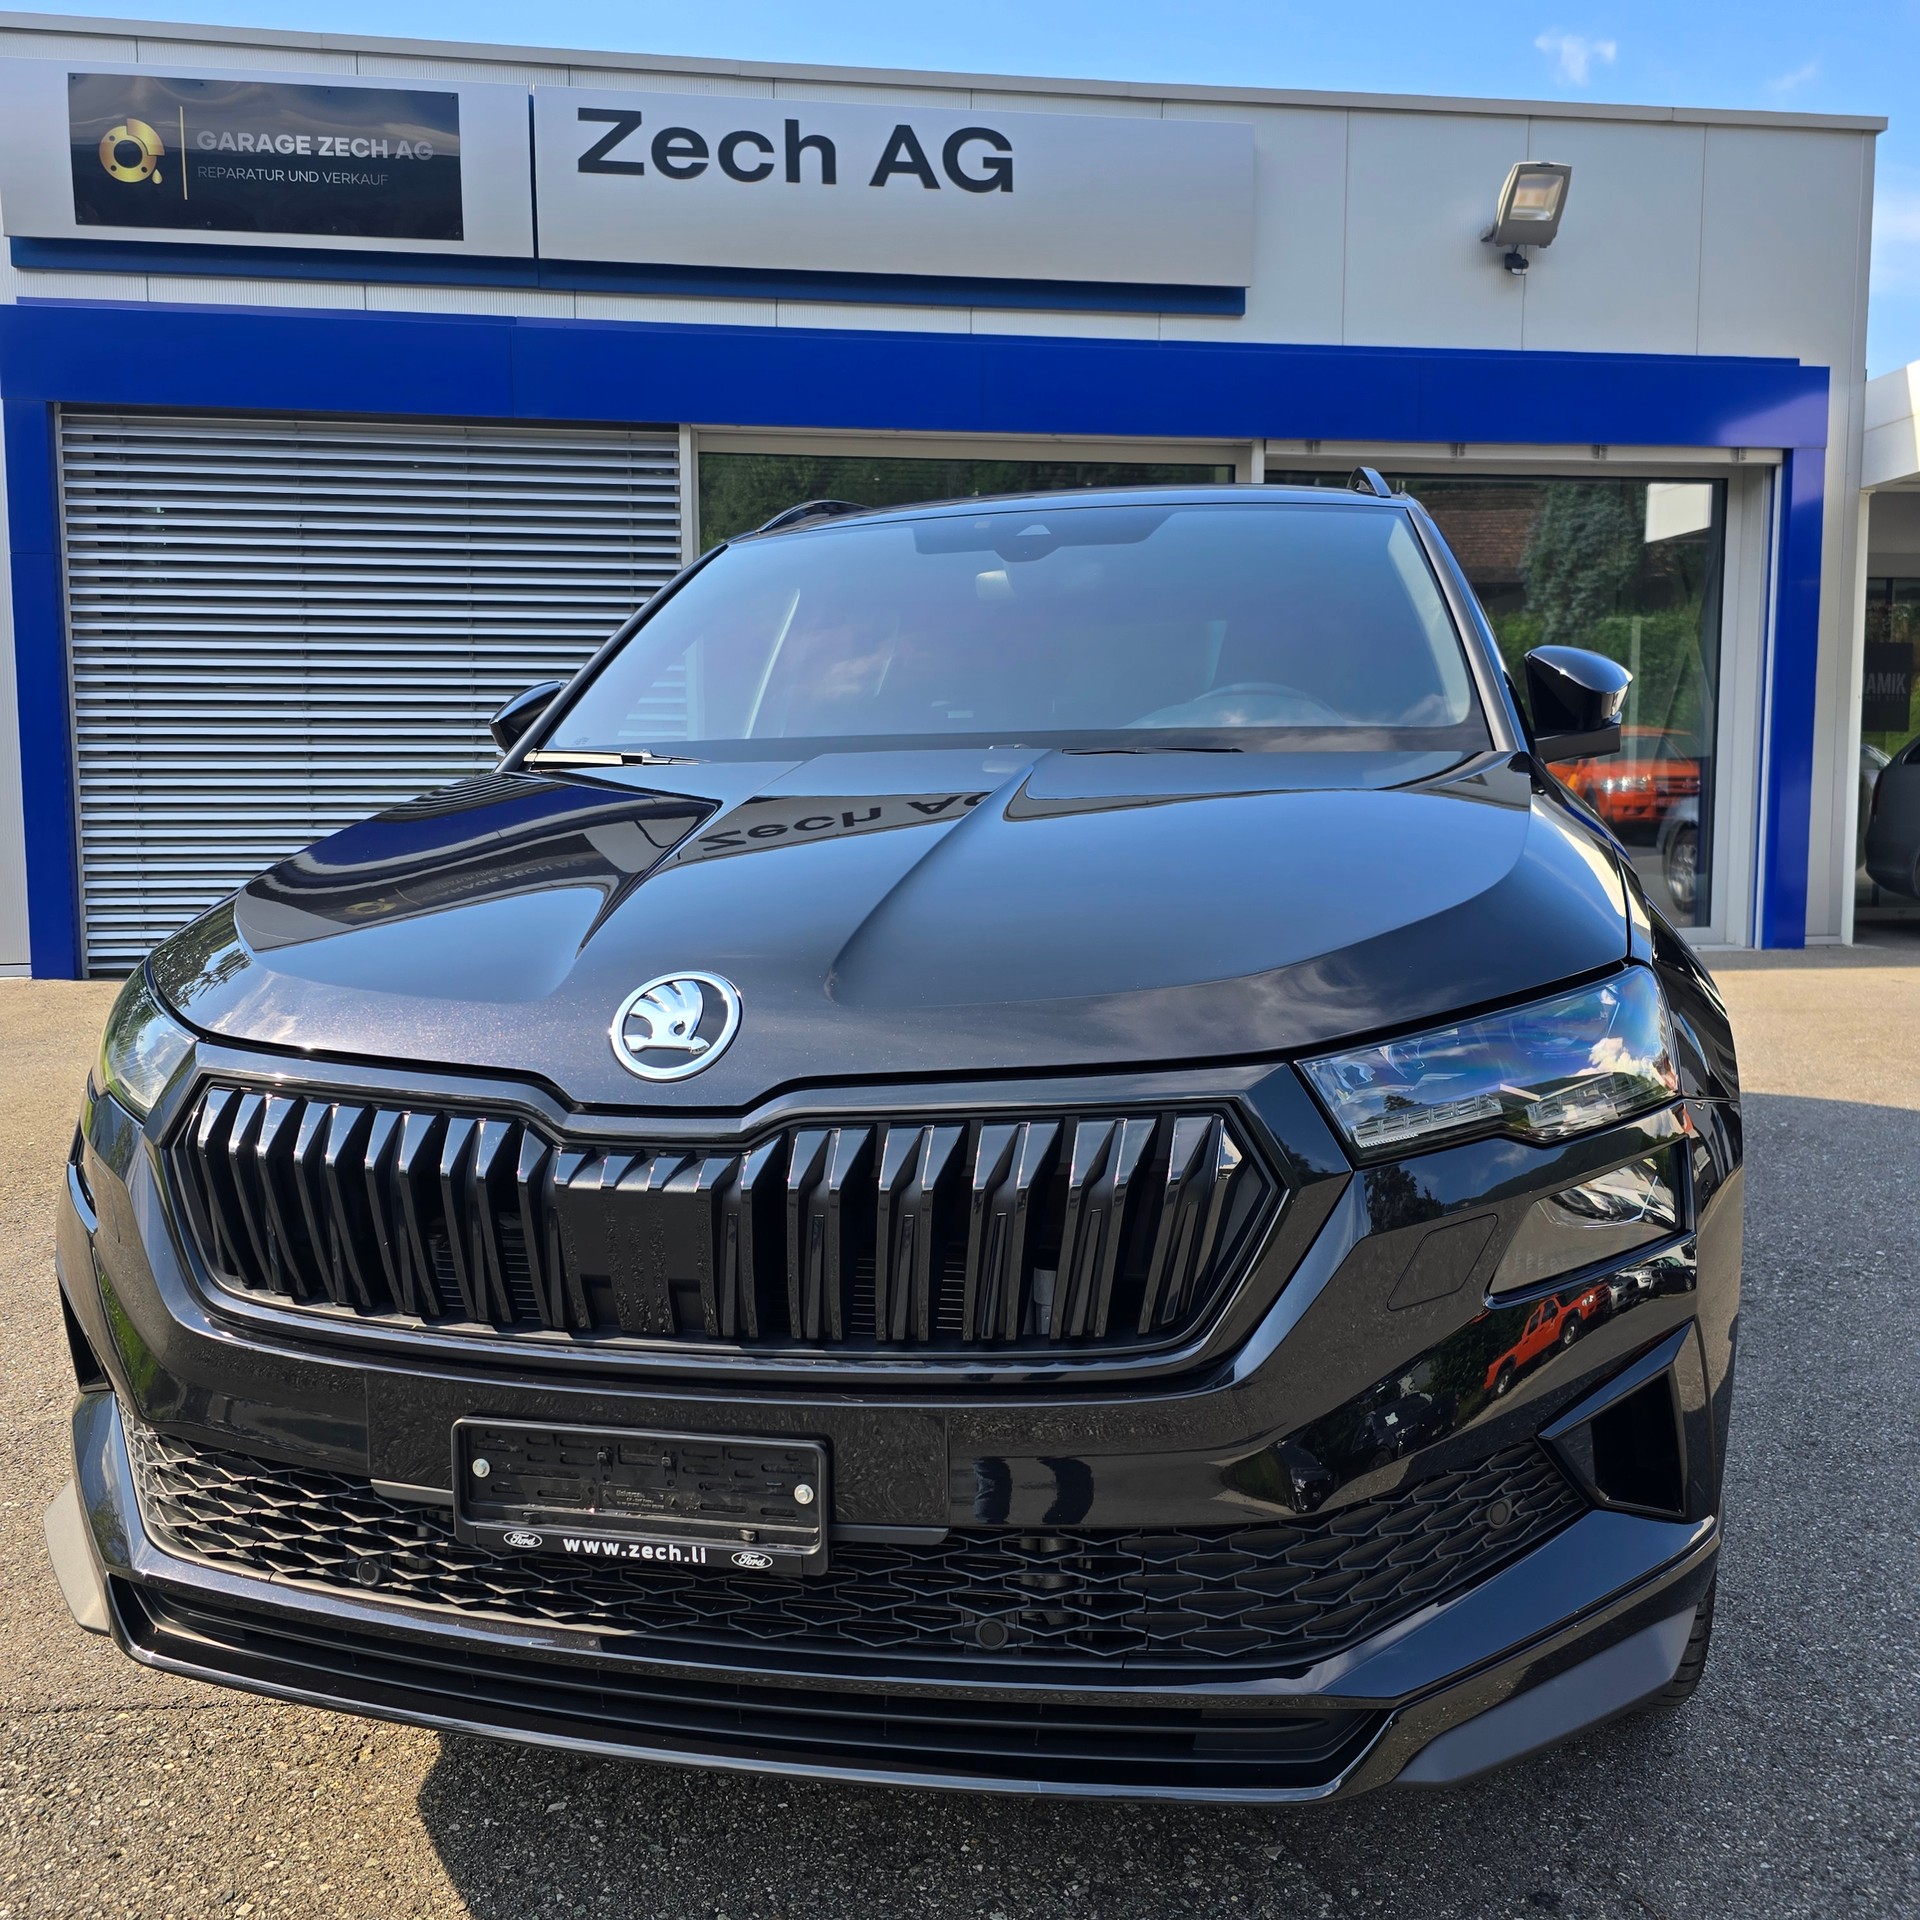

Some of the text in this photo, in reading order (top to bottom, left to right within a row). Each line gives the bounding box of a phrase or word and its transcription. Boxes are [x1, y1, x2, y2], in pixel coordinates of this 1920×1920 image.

[197, 130, 434, 160] GARAGE ZECH AG
[577, 107, 1014, 193] Zech AG
[198, 166, 389, 186] REPARATUR UND VERKAUF
[508, 1531, 538, 1547] Ford
[563, 1538, 706, 1564] www.zech.li
[736, 1552, 768, 1569] Ford
